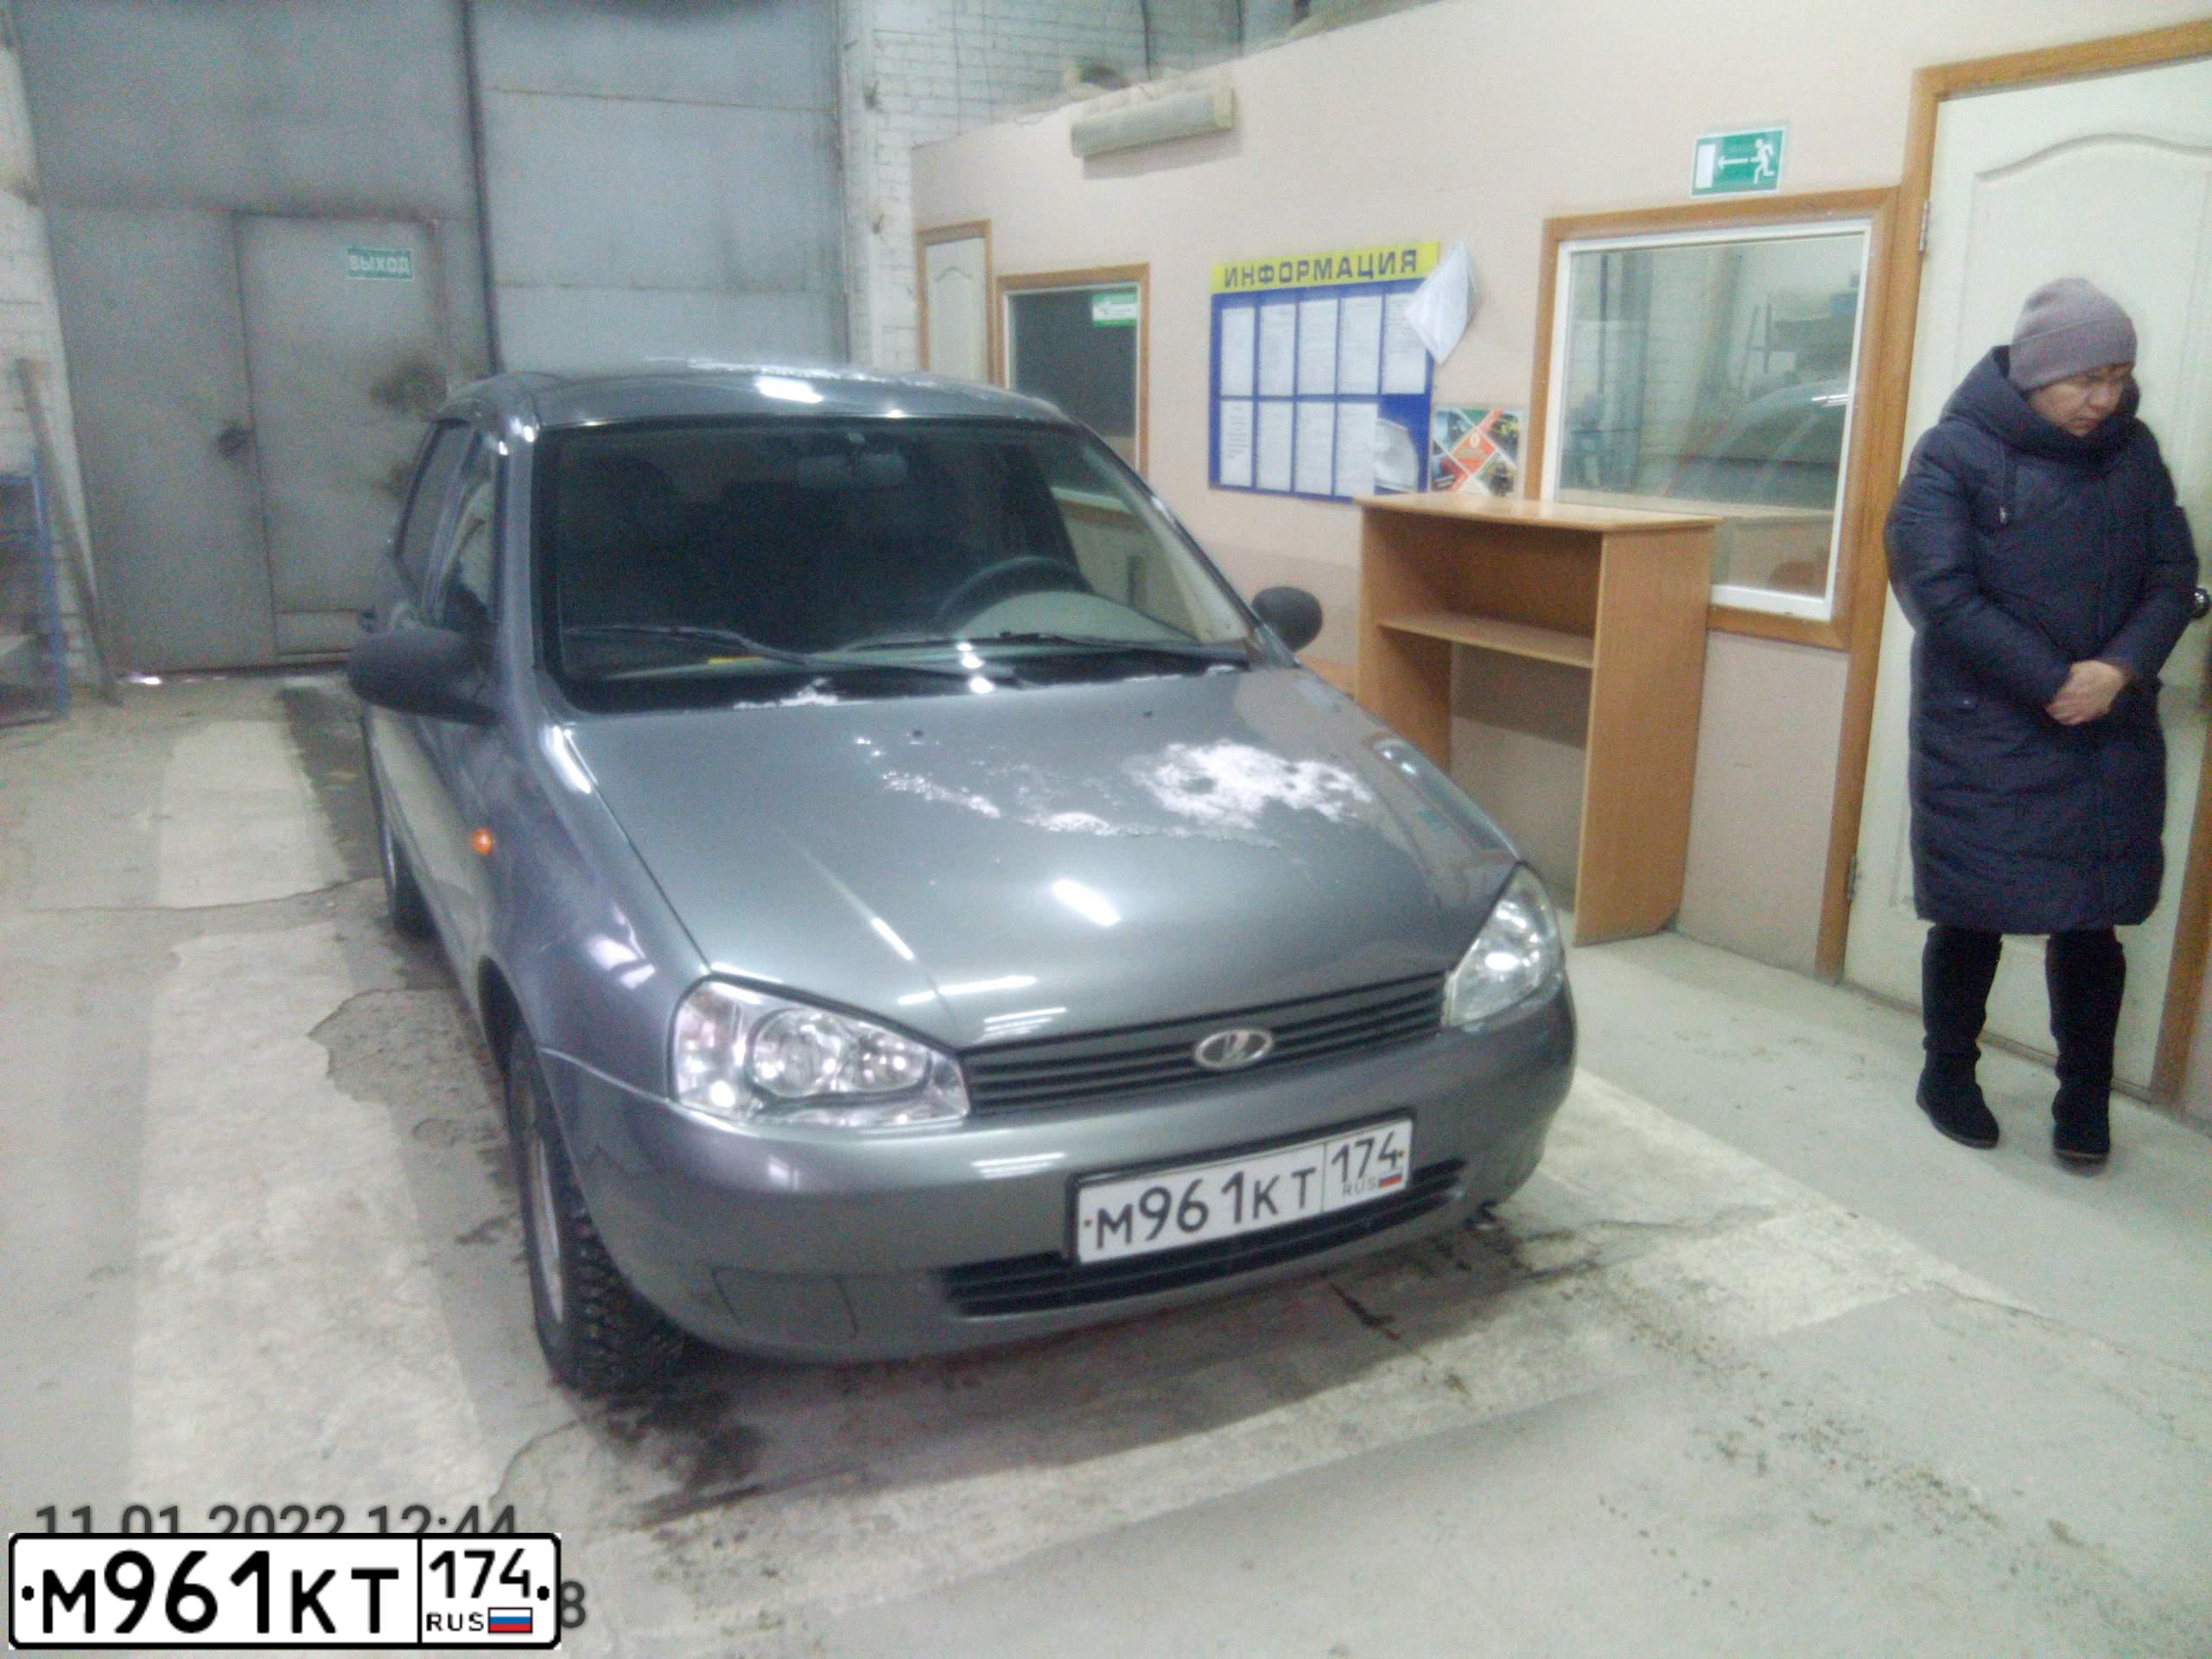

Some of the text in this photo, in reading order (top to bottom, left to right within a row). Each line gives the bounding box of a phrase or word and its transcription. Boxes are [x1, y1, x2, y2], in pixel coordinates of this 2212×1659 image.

[349, 255, 409, 274] ВЫХОД
[1224, 249, 1417, 288] ИНФОРМАЦИЯ
[1096, 1131, 1397, 1249] М961КТ 174
